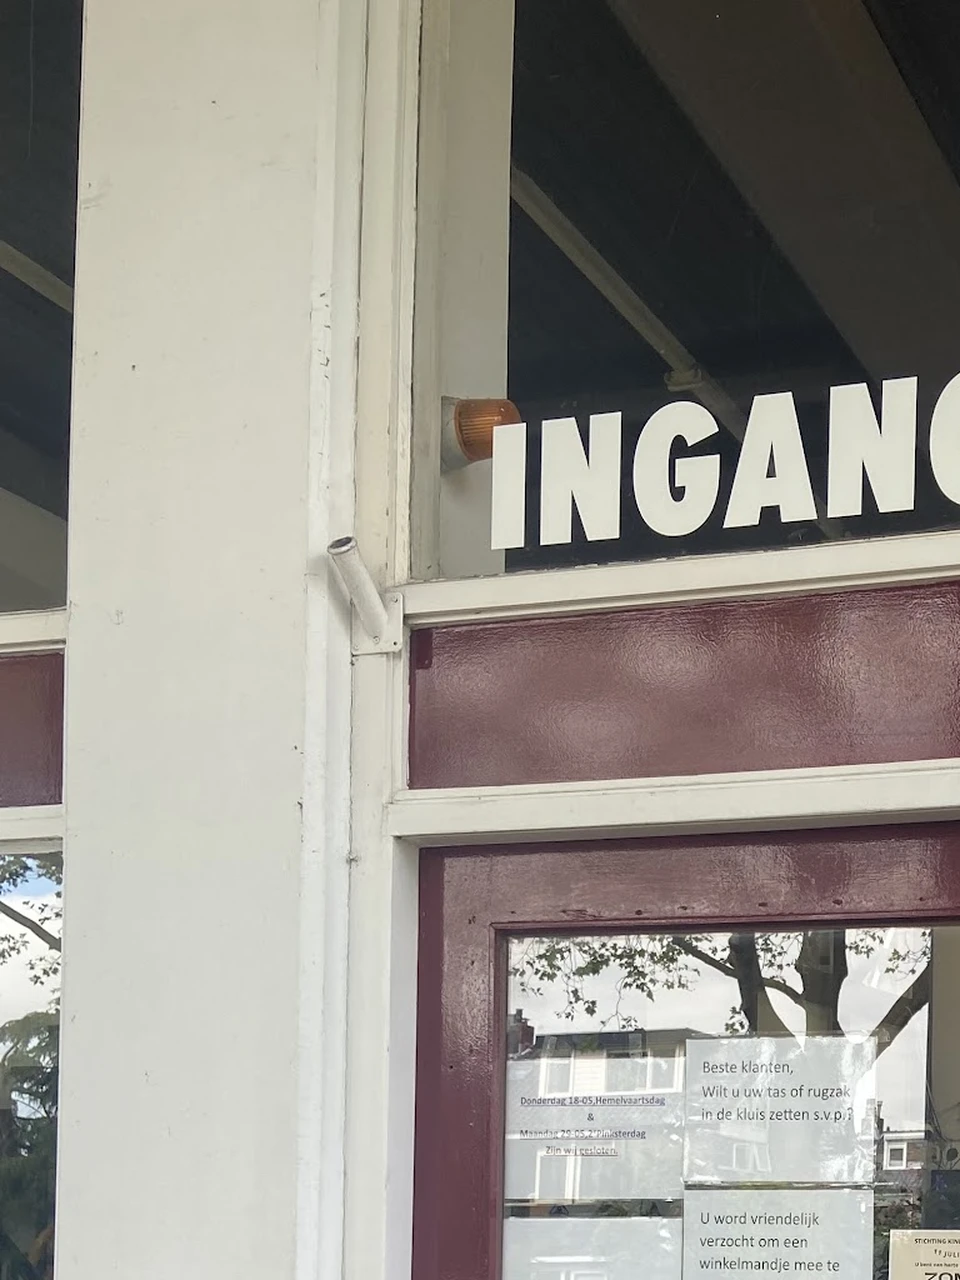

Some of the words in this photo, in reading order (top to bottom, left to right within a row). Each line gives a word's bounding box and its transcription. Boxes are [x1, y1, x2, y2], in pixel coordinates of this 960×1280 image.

[702, 1061, 737, 1074] Beste
[741, 1061, 794, 1076] klanten,
[702, 1084, 729, 1099] Wilt
[732, 1087, 740, 1099] u
[743, 1087, 763, 1099] uw
[766, 1086, 787, 1099] tas
[790, 1083, 805, 1099] of
[808, 1084, 851, 1102] rugzak
[701, 1107, 713, 1121] in
[716, 1107, 734, 1122] de
[738, 1107, 766, 1122] kluis
[769, 1108, 811, 1122] zetten
[700, 1212, 710, 1226] U
[713, 1211, 747, 1226] word
[750, 1211, 820, 1229] vriendelijk
[699, 1234, 755, 1249] verzocht
[758, 1237, 780, 1249] om
[783, 1237, 809, 1249] een
[699, 1257, 791, 1274] winkelmandje
[794, 1259, 824, 1272] mee
[826, 1258, 840, 1272] te
